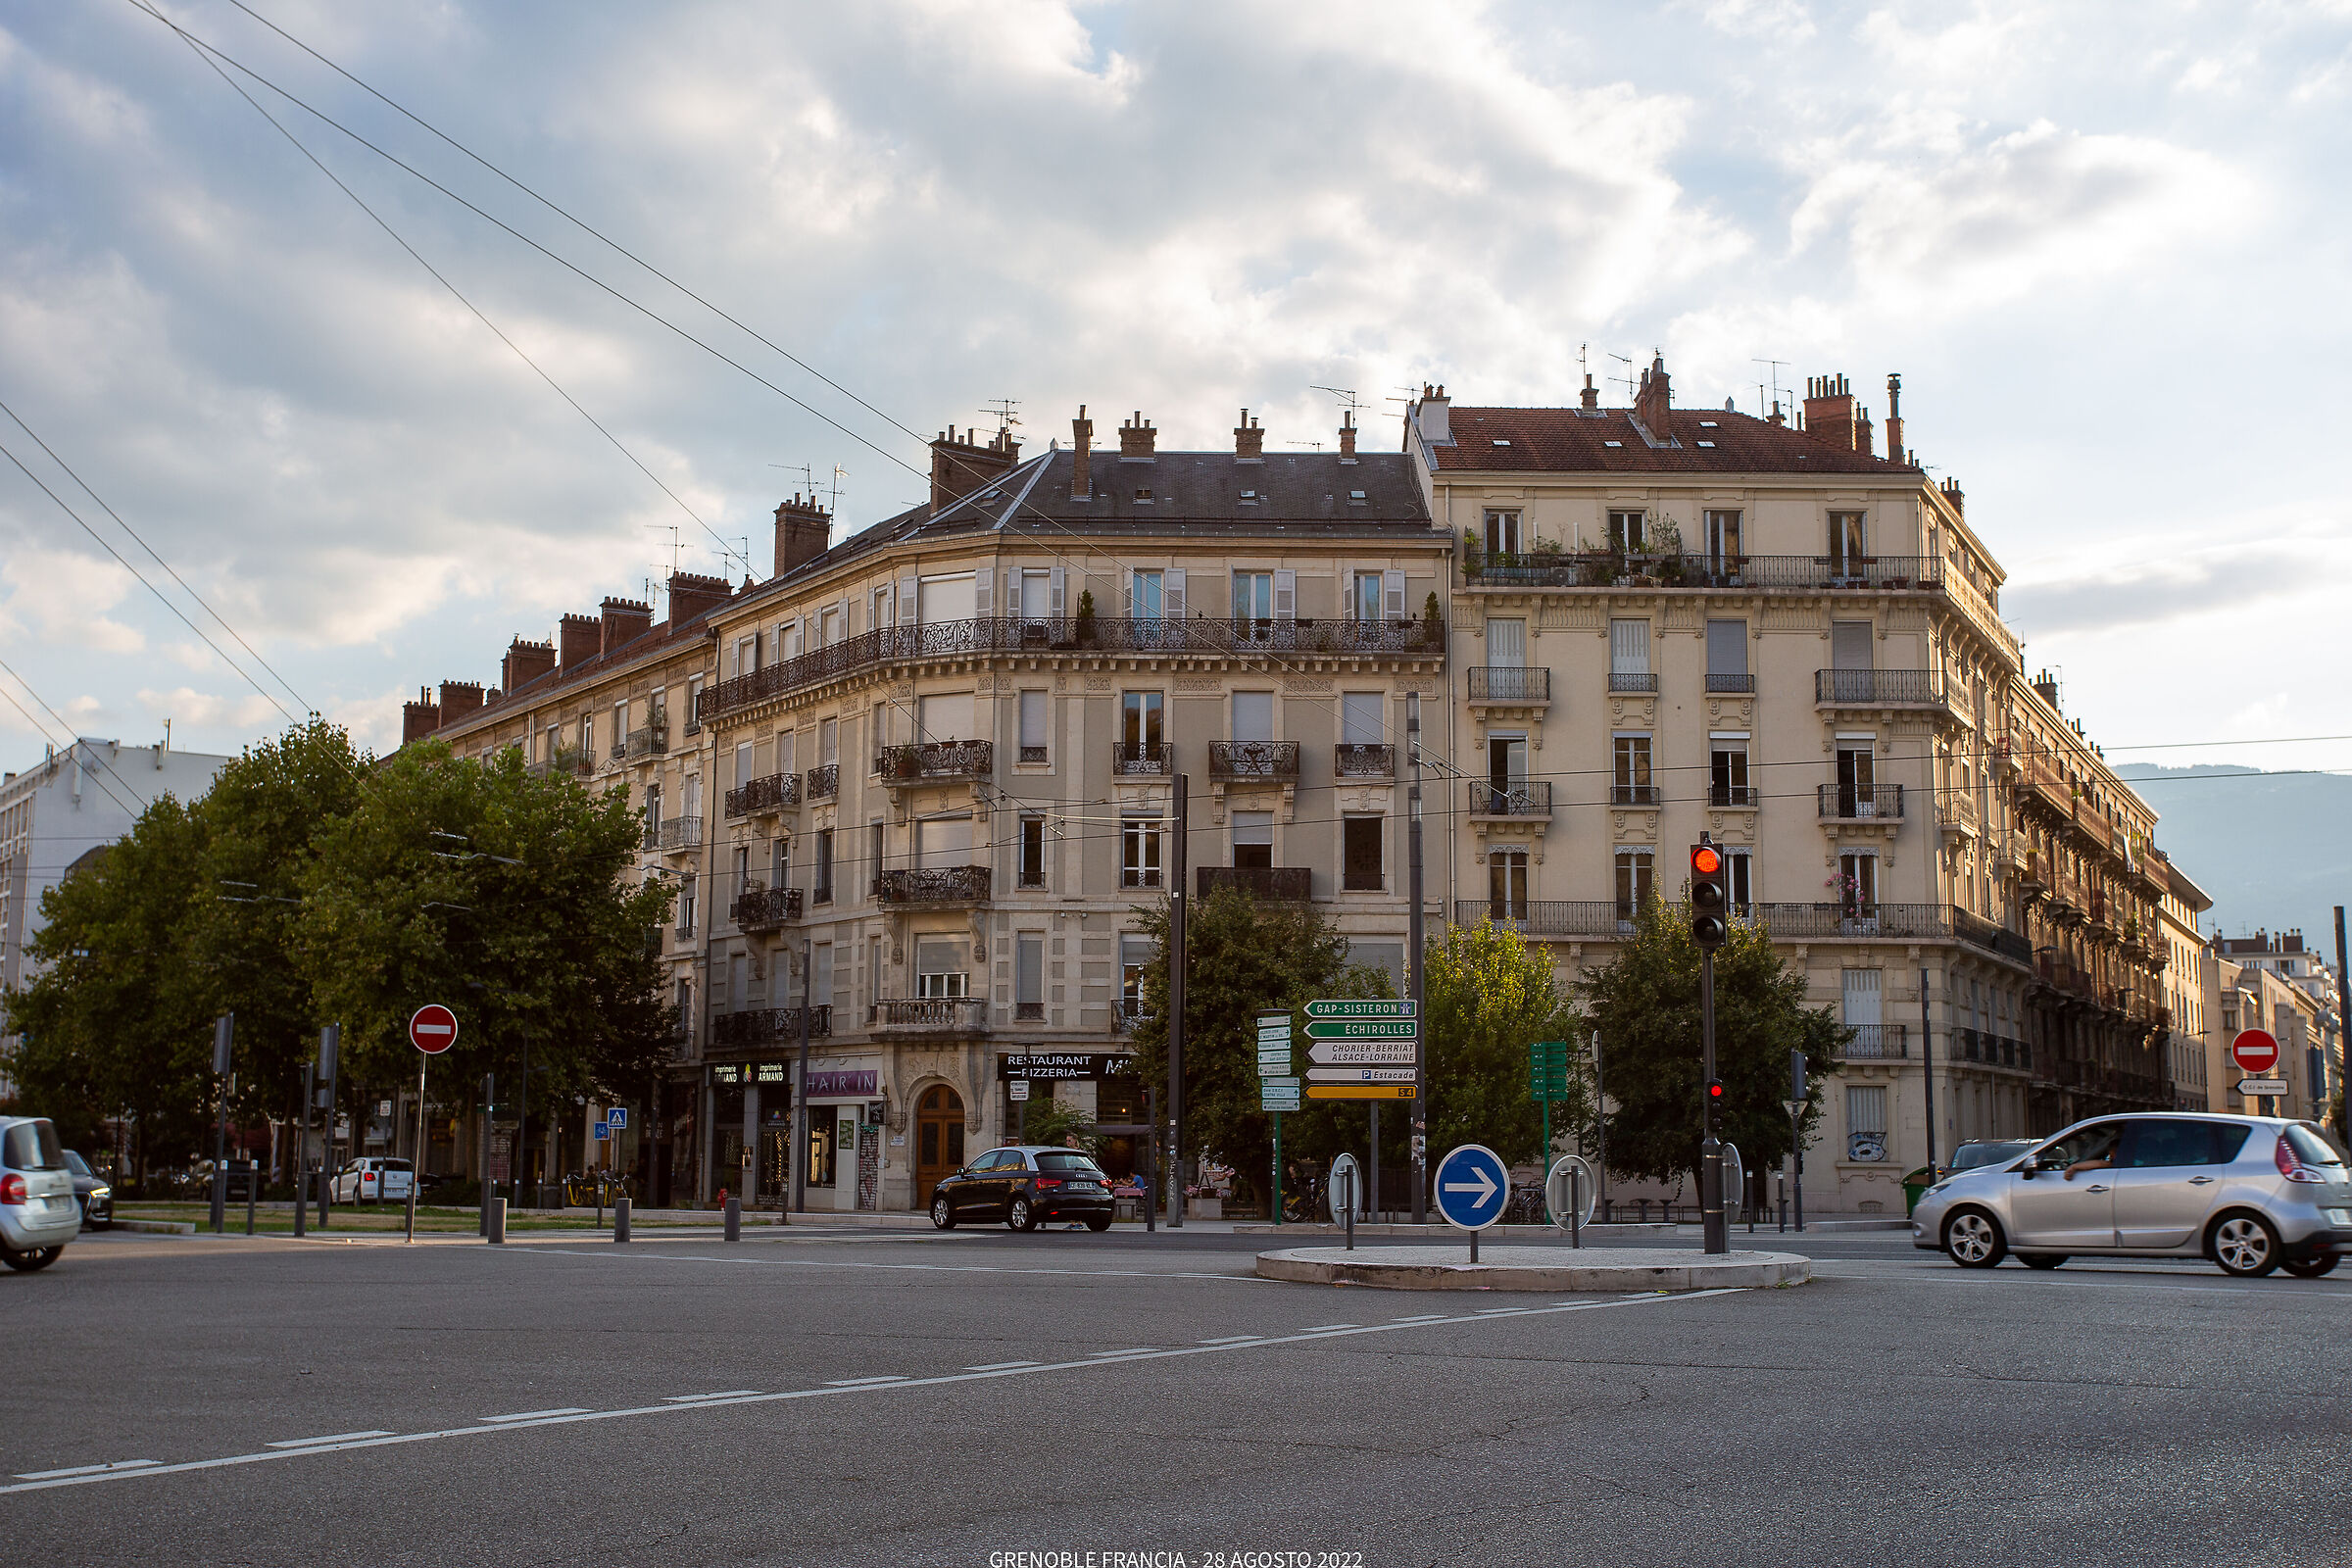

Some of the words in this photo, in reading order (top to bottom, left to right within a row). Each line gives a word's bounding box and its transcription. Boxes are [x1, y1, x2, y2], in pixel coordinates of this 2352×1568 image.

[1316, 1004, 1397, 1013] GAP-SISTERON
[1345, 1024, 1412, 1034] ÉCHIROLLES
[714, 1064, 737, 1074] imprimerie
[760, 1063, 782, 1073] imprimerie
[1021, 1068, 1078, 1077] PIZZERIA
[758, 1072, 784, 1082] ARMAND
[1374, 1070, 1414, 1079] Estacade
[858, 1073, 874, 1092] IN
